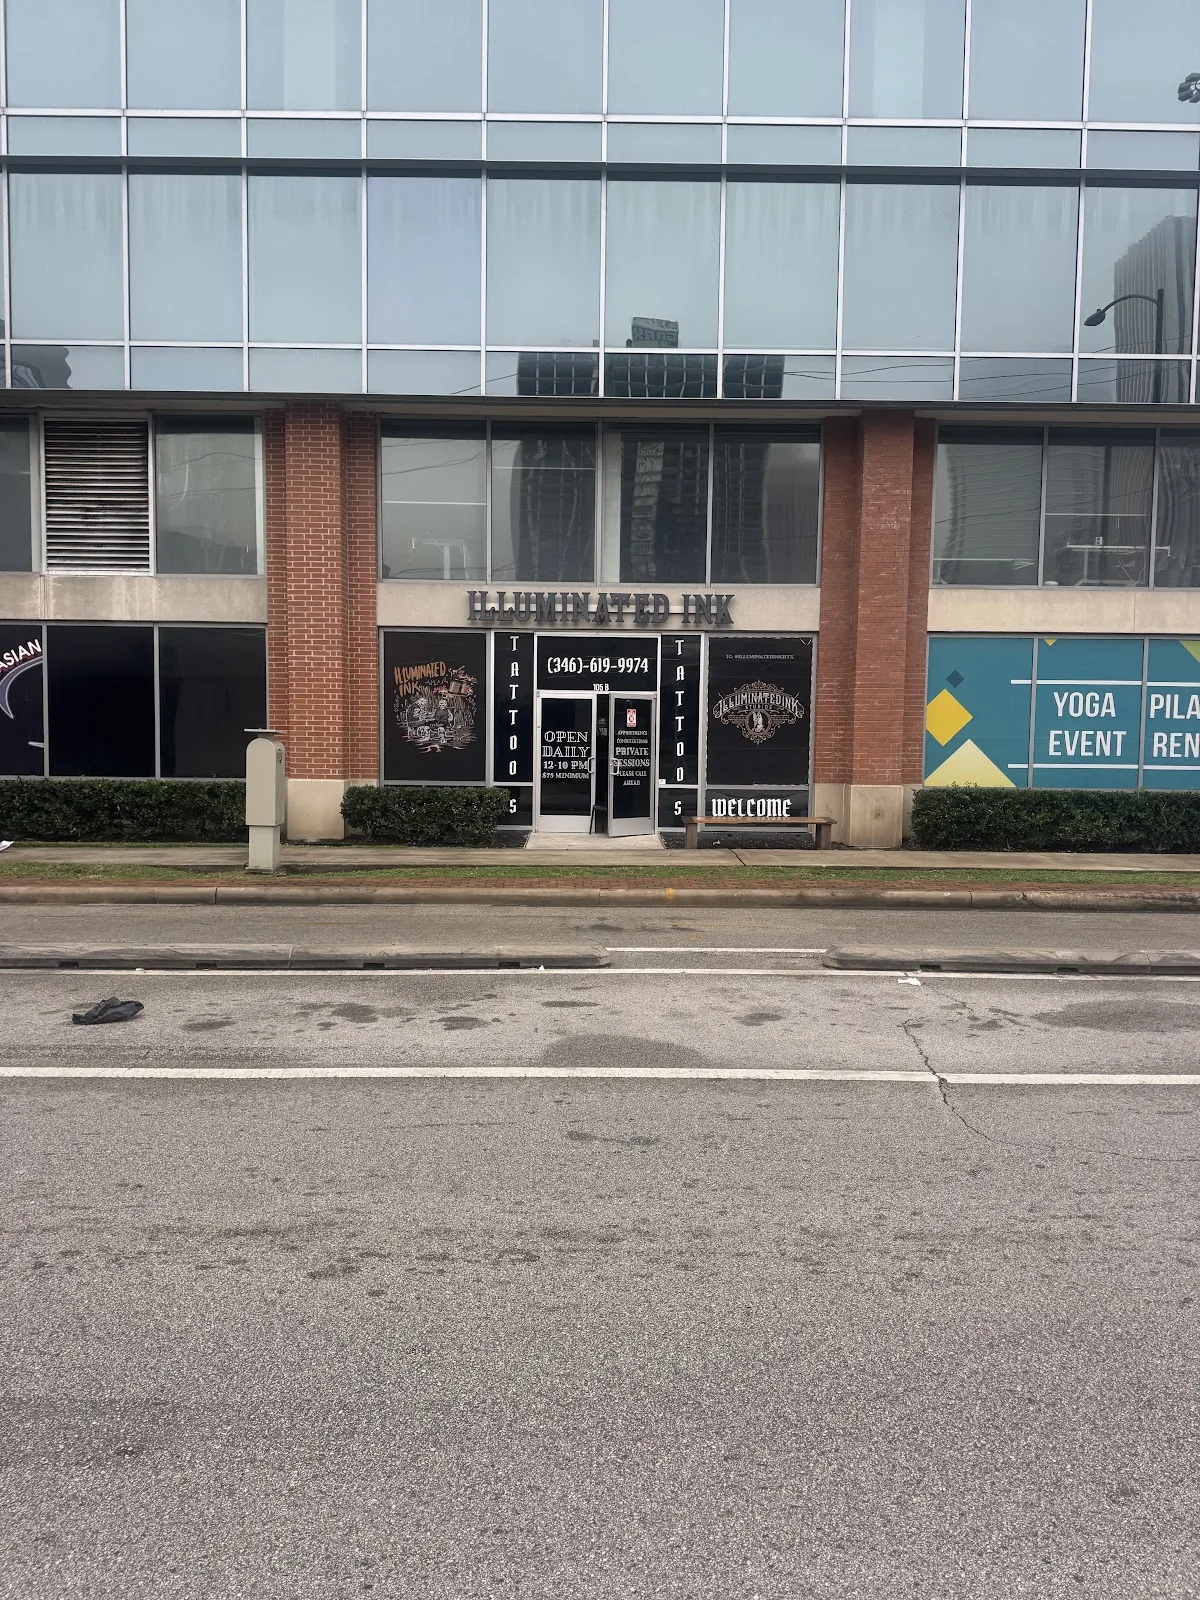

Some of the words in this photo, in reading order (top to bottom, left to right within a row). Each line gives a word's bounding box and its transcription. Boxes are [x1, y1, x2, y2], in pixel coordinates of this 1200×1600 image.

[467, 591, 670, 624] ILLUMINATED
[681, 593, 736, 625] INK
[394, 660, 446, 685] ILLUMINATED
[547, 657, 649, 674] (346)-619-9974
[399, 681, 421, 698] INK
[593, 683, 604, 691] 105
[1053, 691, 1116, 718] YOGA
[1149, 694, 1200, 719] PILA
[544, 731, 589, 742] OPEN
[1048, 730, 1127, 757] EVENT
[1152, 732, 1200, 758] REN
[542, 746, 590, 757] DAILY
[615, 747, 649, 755] PRIVATE
[543, 761, 569, 769] 12-10
[570, 761, 588, 770] PM
[613, 758, 650, 767] SESSIONS
[542, 771, 554, 779] $75
